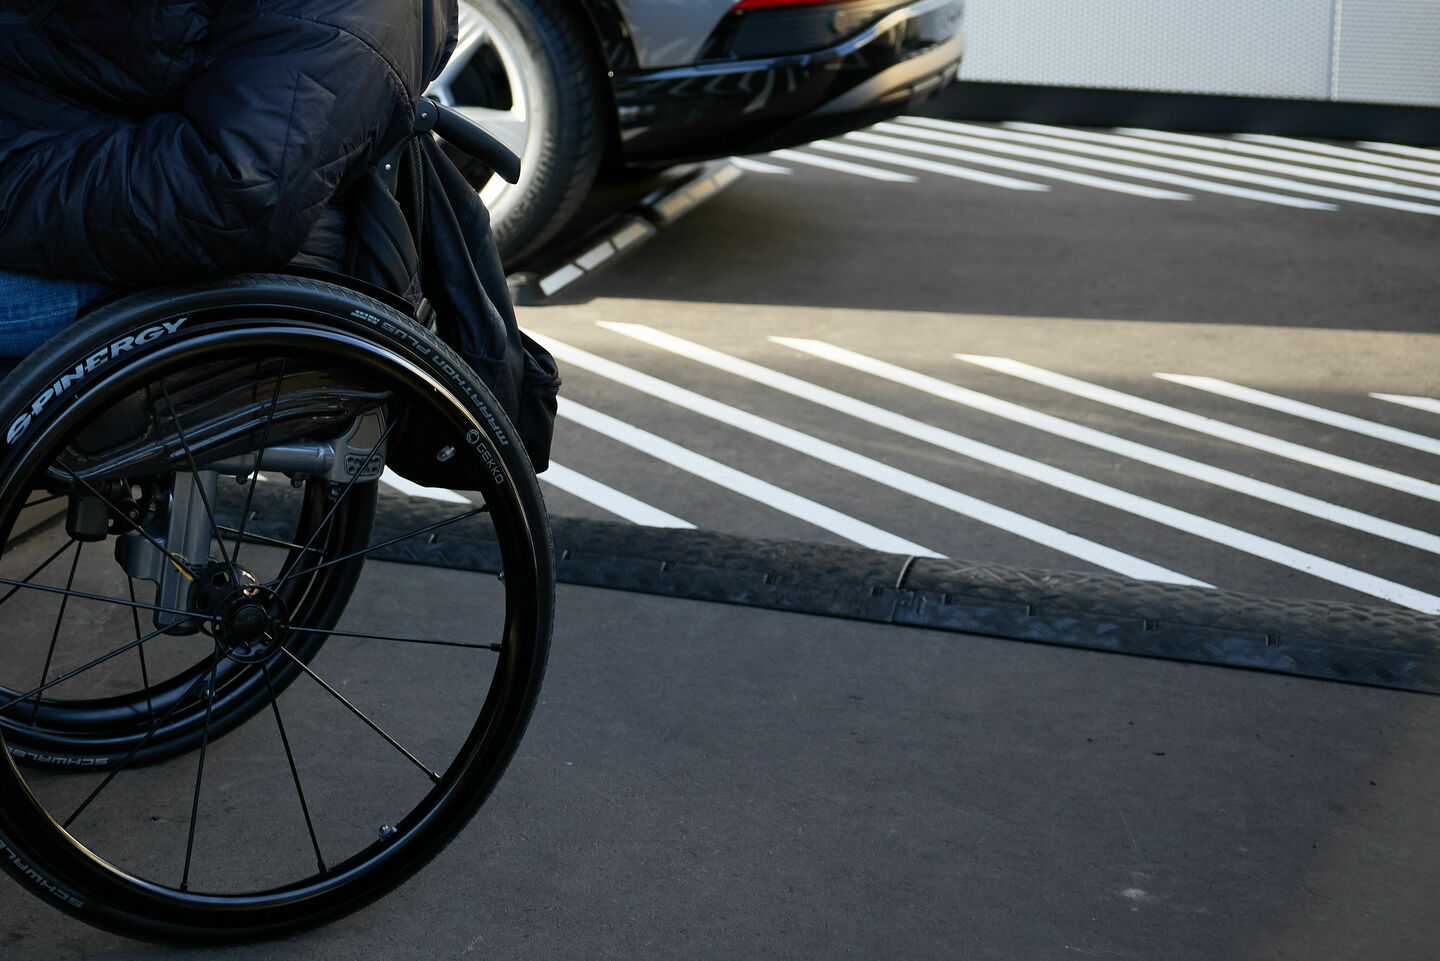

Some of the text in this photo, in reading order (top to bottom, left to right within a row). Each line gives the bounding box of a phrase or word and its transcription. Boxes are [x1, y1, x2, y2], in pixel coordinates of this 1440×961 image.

[6, 316, 189, 445] SPINERGY
[380, 321, 509, 447] MARATHON PLUS
[476, 442, 505, 485] GEKKO
